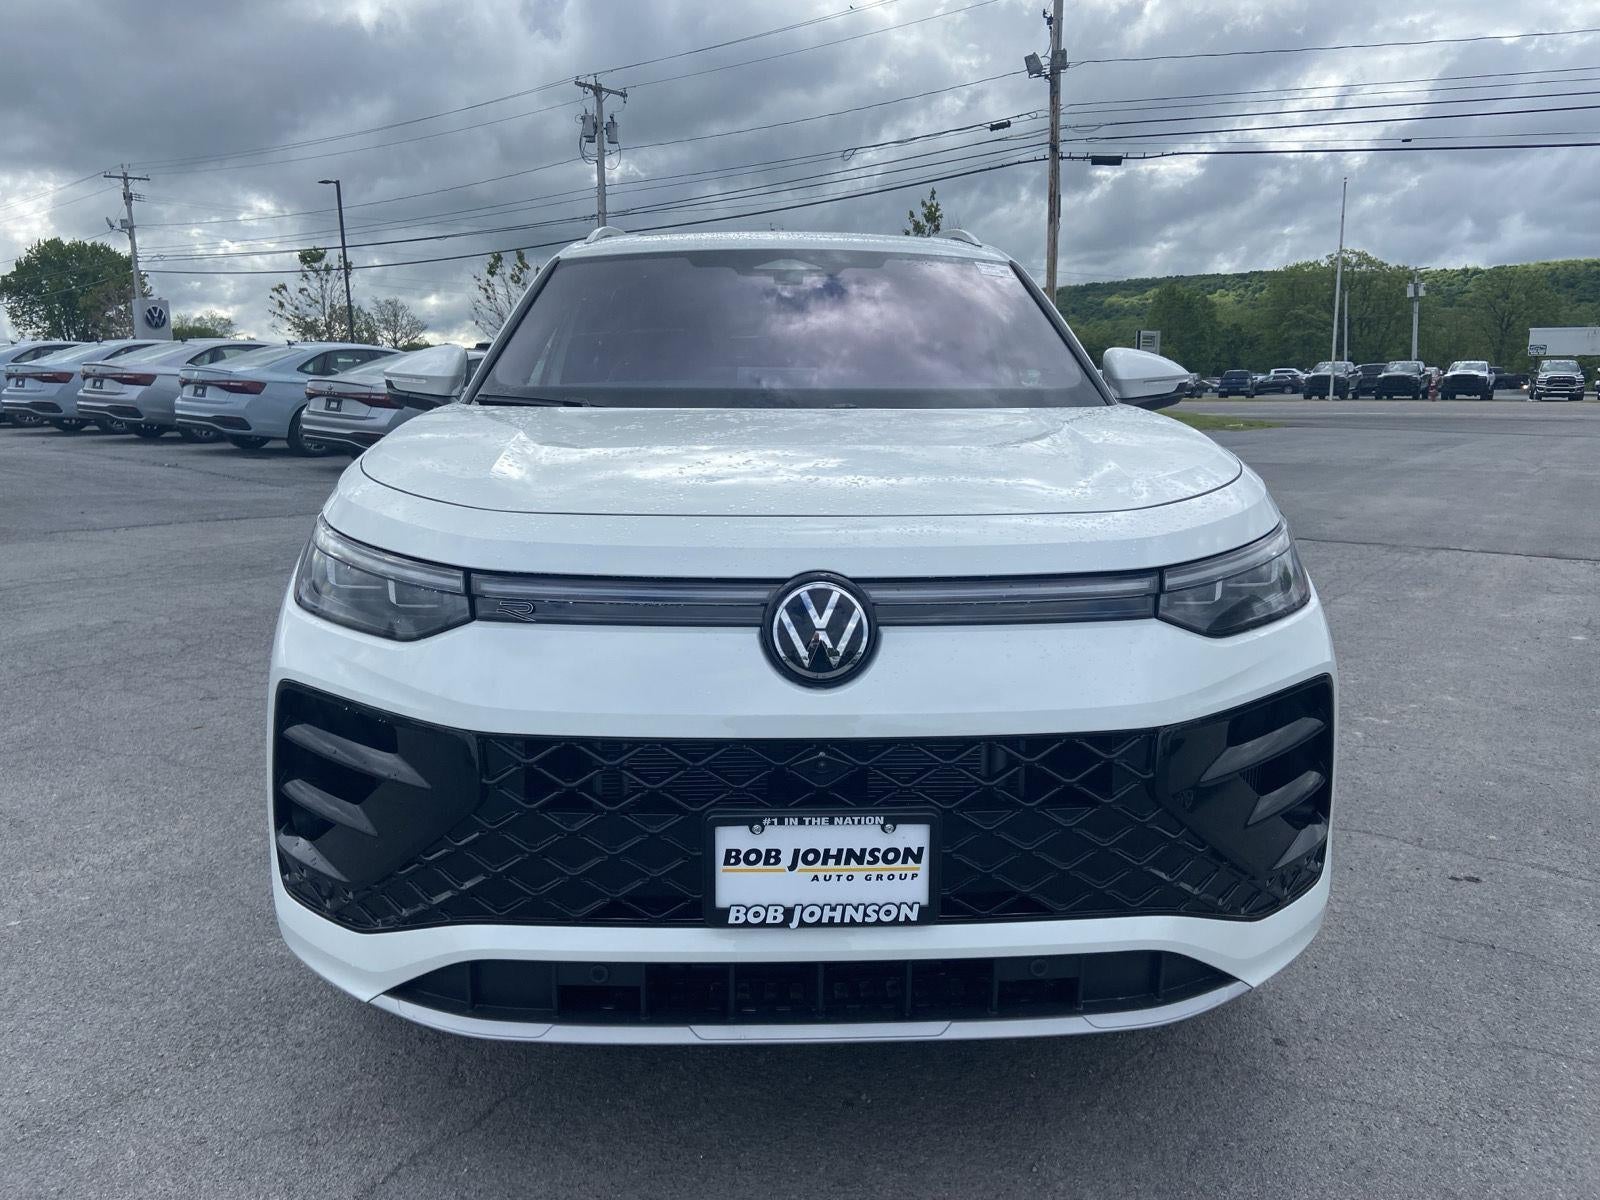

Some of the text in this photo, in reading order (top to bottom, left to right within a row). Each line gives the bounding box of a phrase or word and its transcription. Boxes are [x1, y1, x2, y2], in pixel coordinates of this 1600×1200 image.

[777, 587, 864, 671] VW
[762, 816, 884, 826] #1 IN THE NATION
[722, 846, 924, 871] BOB JOHNSON
[811, 873, 919, 882] AUTO GROUP
[727, 903, 920, 929] BOB JOHNSON
